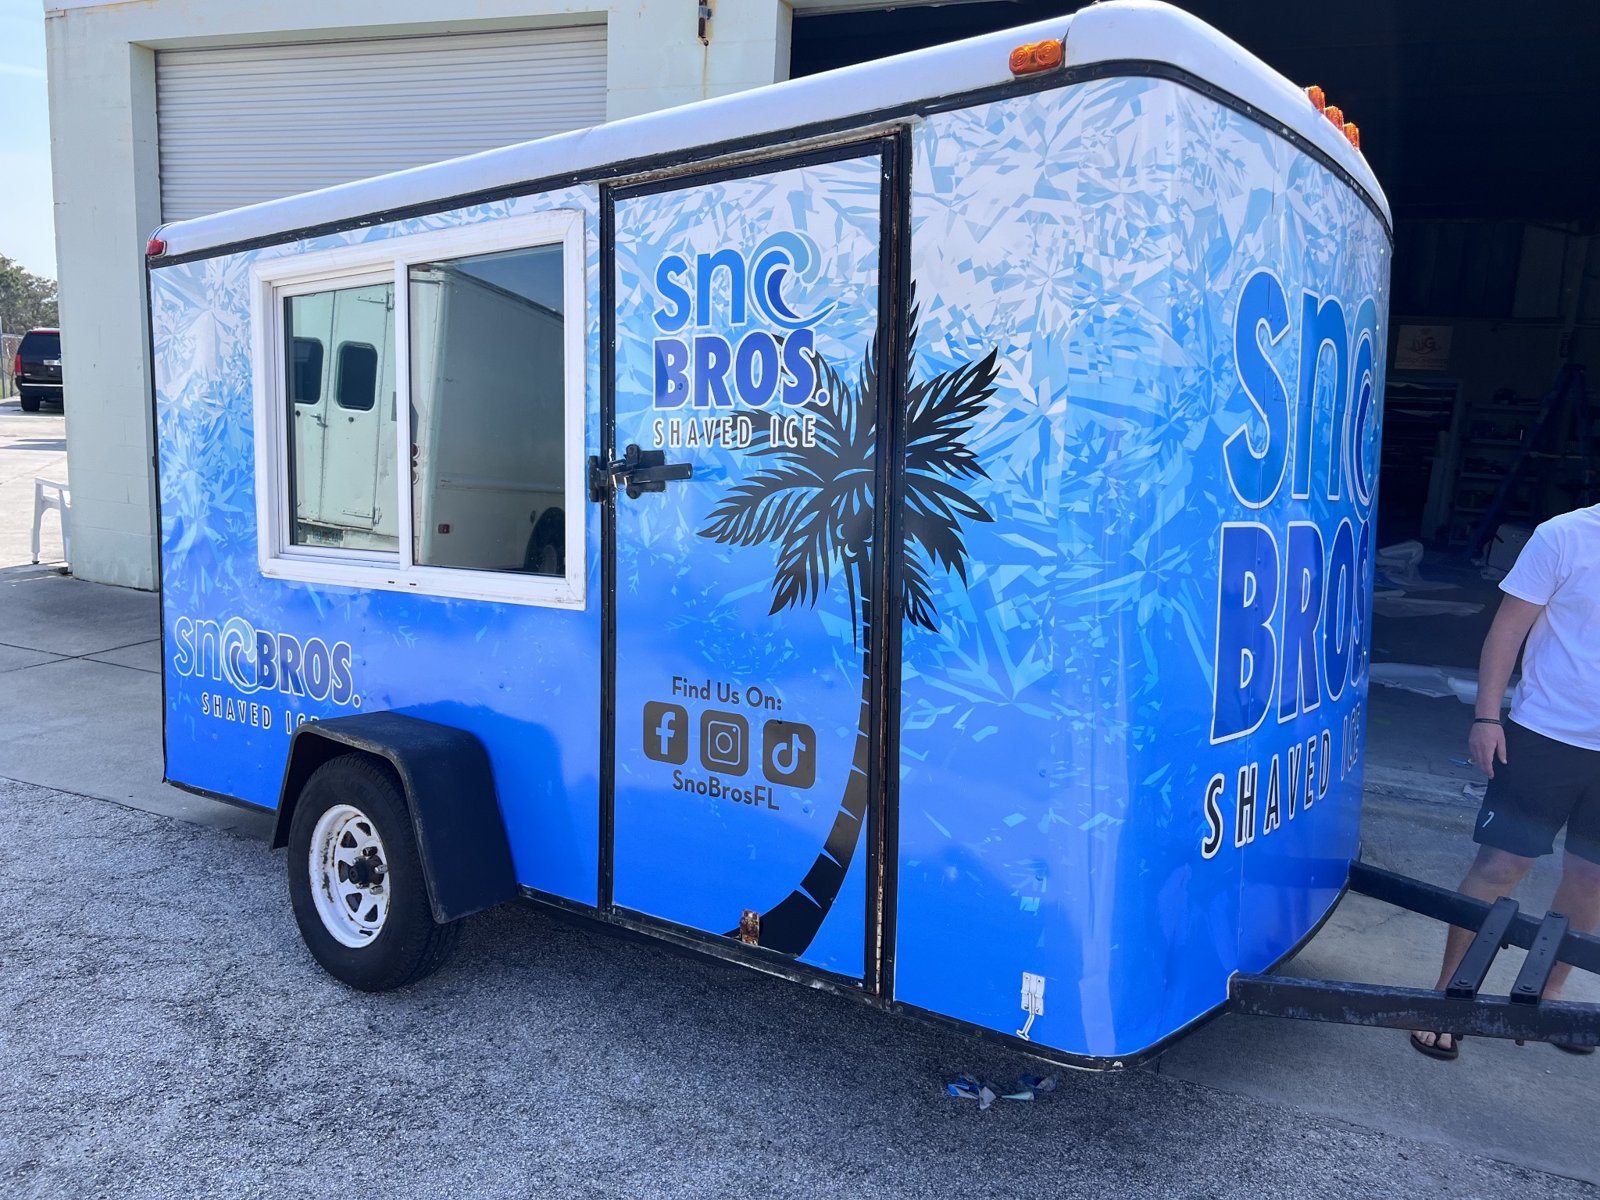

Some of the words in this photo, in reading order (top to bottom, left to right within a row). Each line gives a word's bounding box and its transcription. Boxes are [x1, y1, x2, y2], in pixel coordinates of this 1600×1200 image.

[653, 329, 831, 411] BROS.
[653, 416, 752, 448] SHAVED
[769, 415, 817, 448] ICE
[202, 691, 272, 730] SHAVED
[672, 675, 711, 701] Find
[717, 681, 740, 705] Us
[746, 686, 782, 711] On:
[672, 769, 780, 811] SnoBrosFL
[1201, 728, 1332, 860] SHAVED
